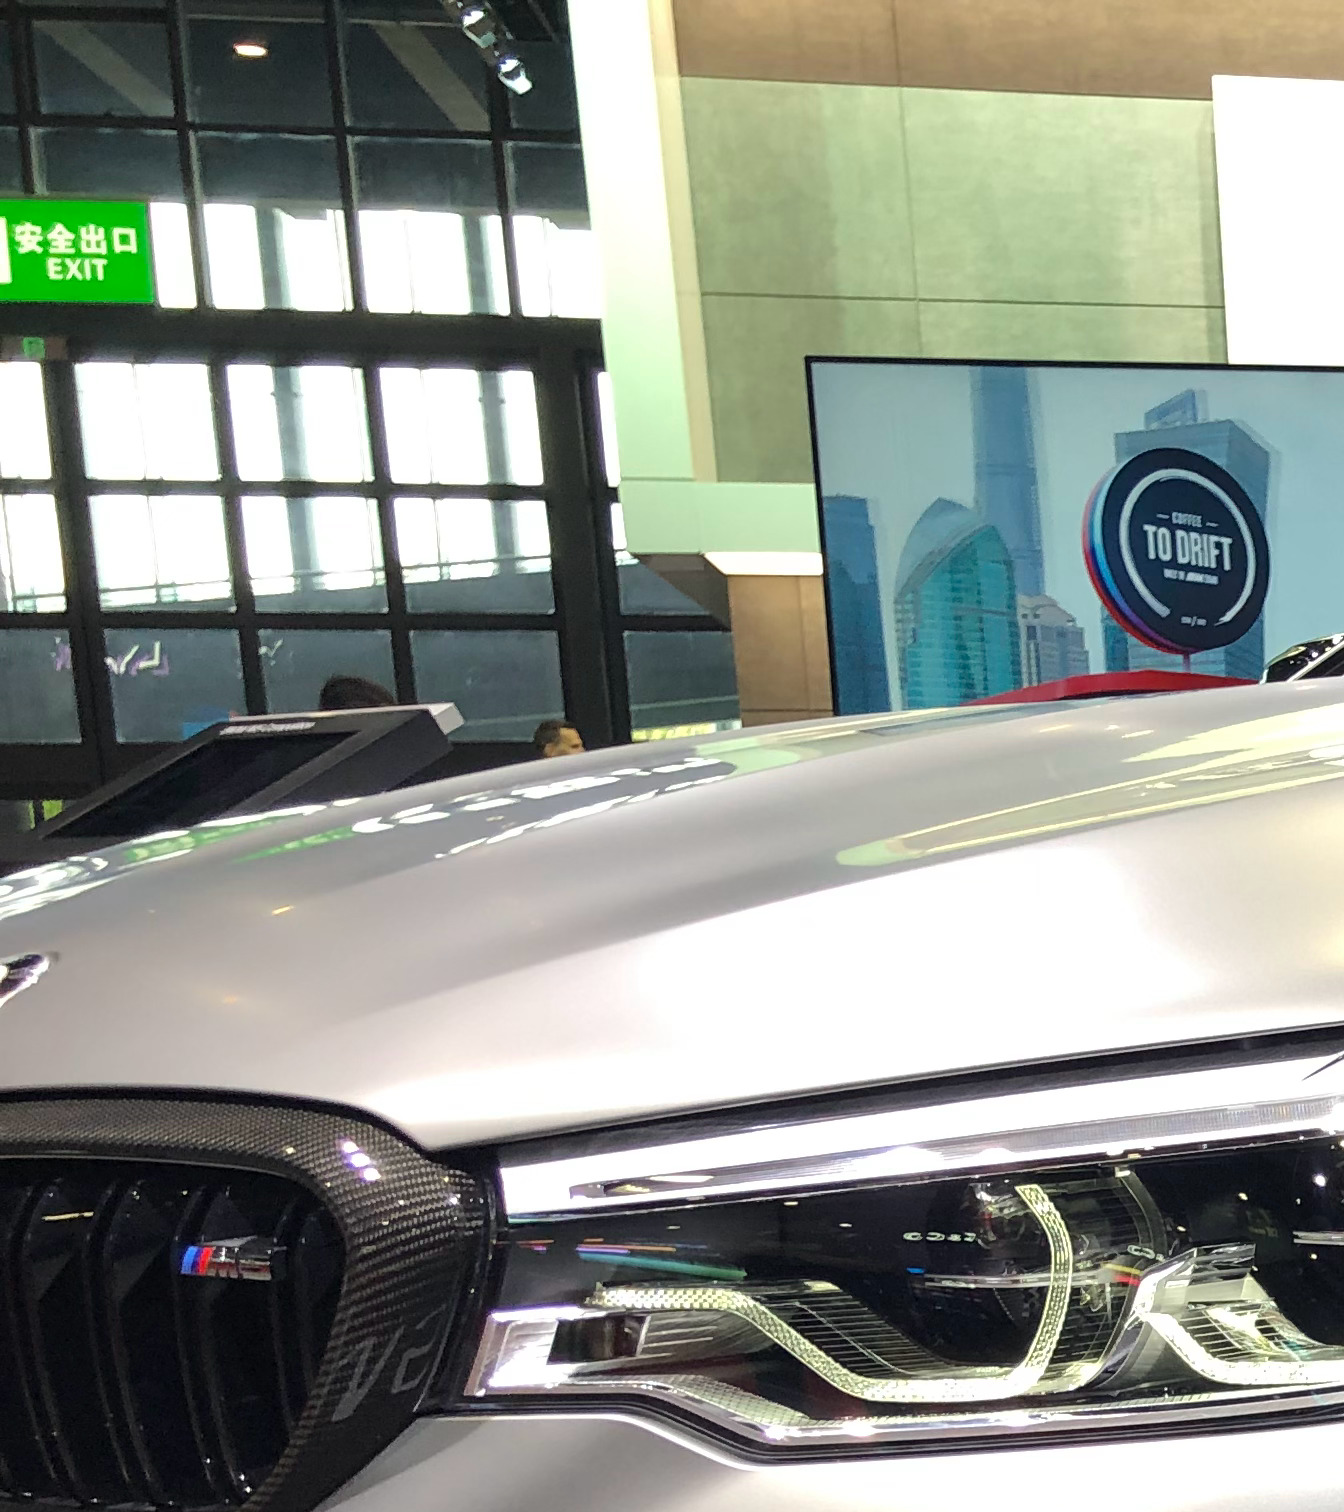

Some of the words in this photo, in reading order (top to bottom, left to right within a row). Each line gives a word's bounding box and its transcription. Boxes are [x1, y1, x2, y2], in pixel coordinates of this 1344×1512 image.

[13, 221, 138, 255] 安全出口
[46, 257, 108, 281] EXIT
[1171, 511, 1203, 528] COFFEE
[1142, 524, 1173, 562] TO
[1174, 529, 1233, 571] DRIFT
